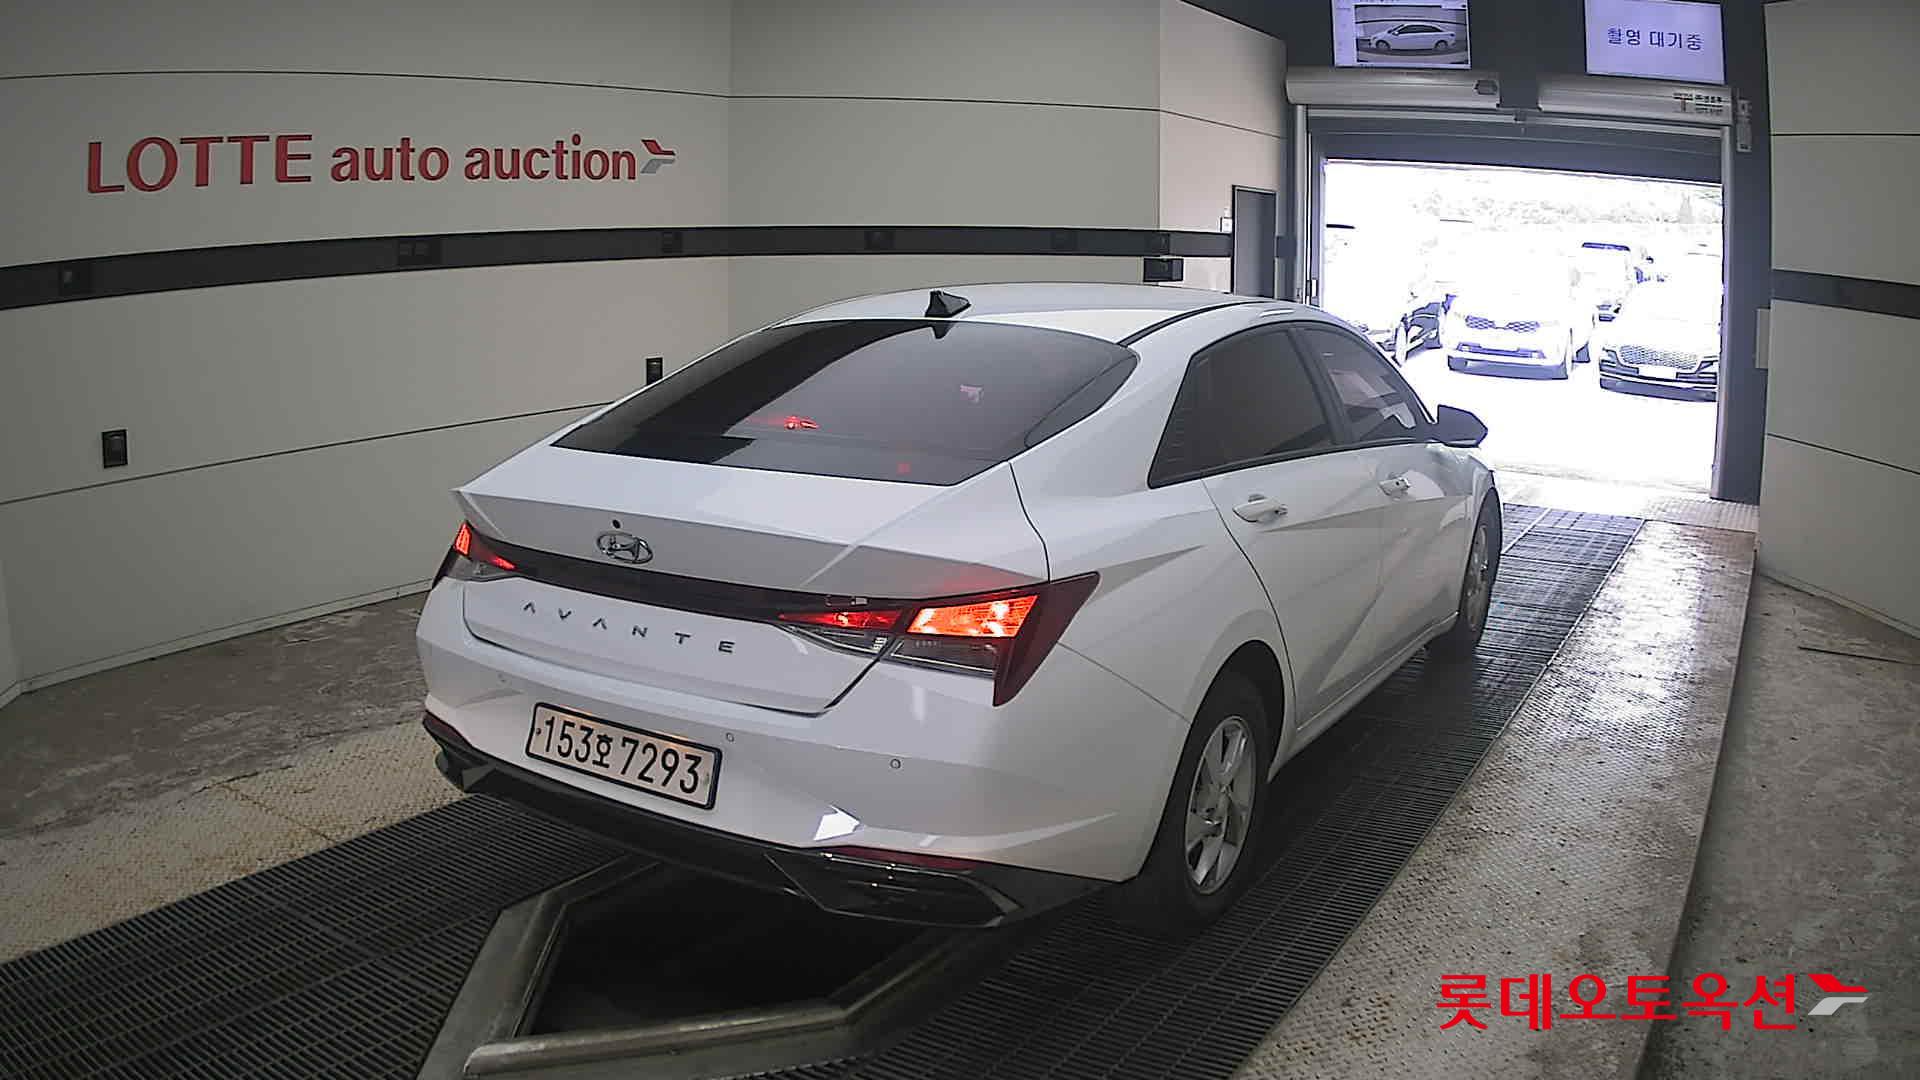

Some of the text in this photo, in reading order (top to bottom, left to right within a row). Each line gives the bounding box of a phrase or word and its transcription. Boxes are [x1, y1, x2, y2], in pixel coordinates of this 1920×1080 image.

[87, 133, 637, 193] LOTTE auto auction
[523, 602, 735, 653] AVANTE
